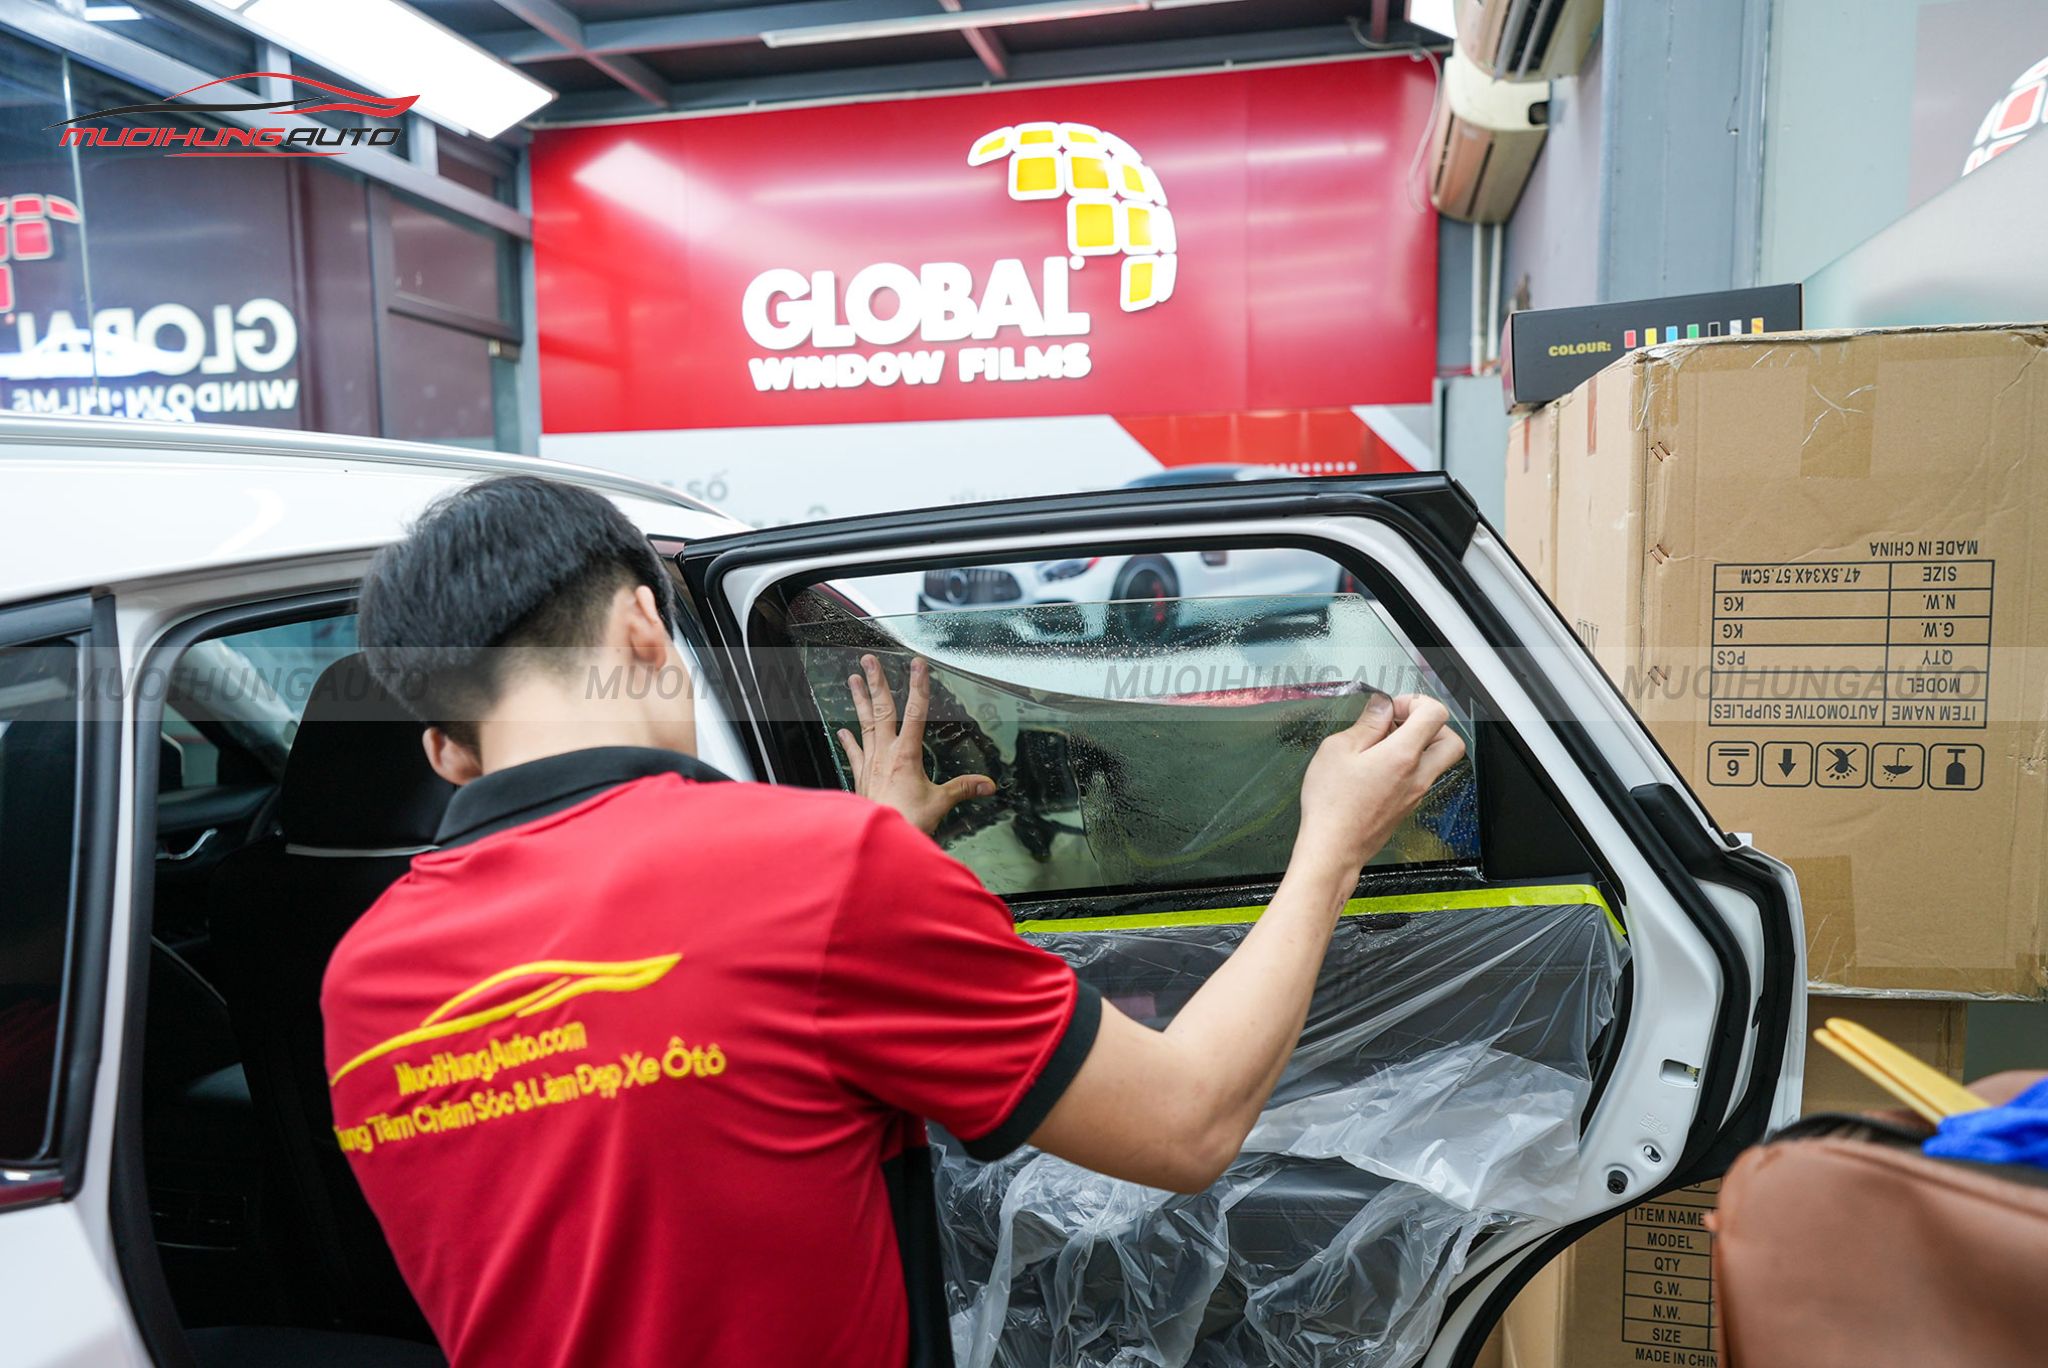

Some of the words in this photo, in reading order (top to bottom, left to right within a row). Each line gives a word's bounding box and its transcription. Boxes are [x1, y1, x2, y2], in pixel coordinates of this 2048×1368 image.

[742, 256, 1090, 350] GLOBAL
[1548, 341, 1612, 357] COLOUR:
[748, 350, 946, 391] WINDOW
[958, 343, 1092, 383] FILMS
[1869, 542, 1914, 557] CHINA
[1918, 541, 1932, 556] IN
[1936, 540, 1979, 555] MADE
[1922, 566, 1957, 582] SIZE
[1723, 596, 1744, 611] KG
[1922, 594, 1956, 610] N.W.
[1722, 624, 1743, 639] KG
[1921, 622, 1955, 638] G.W.
[1717, 650, 1746, 665] PCS
[1922, 650, 1953, 665] QTY
[1906, 678, 1961, 693] MODEL
[1713, 703, 1782, 719] SUPPLIES
[1785, 704, 1879, 720] AUTOMOTIVE
[1891, 705, 1935, 720] NAME
[1939, 705, 1976, 721] ITEM
[512, 1080, 535, 1113] &
[620, 1050, 662, 1089] Xe
[1633, 1207, 1665, 1223] ITEM
[1668, 1209, 1706, 1227] NAME
[1647, 1232, 1694, 1250] MODEL
[1654, 1256, 1681, 1272] QTY
[1653, 1280, 1683, 1297] G.W.
[1652, 1304, 1681, 1320] N.W.
[1652, 1327, 1681, 1344] SIZE
[1635, 1347, 1671, 1364] MADE
[1673, 1351, 1686, 1365] IN
[1688, 1353, 1718, 1368] CHIN
